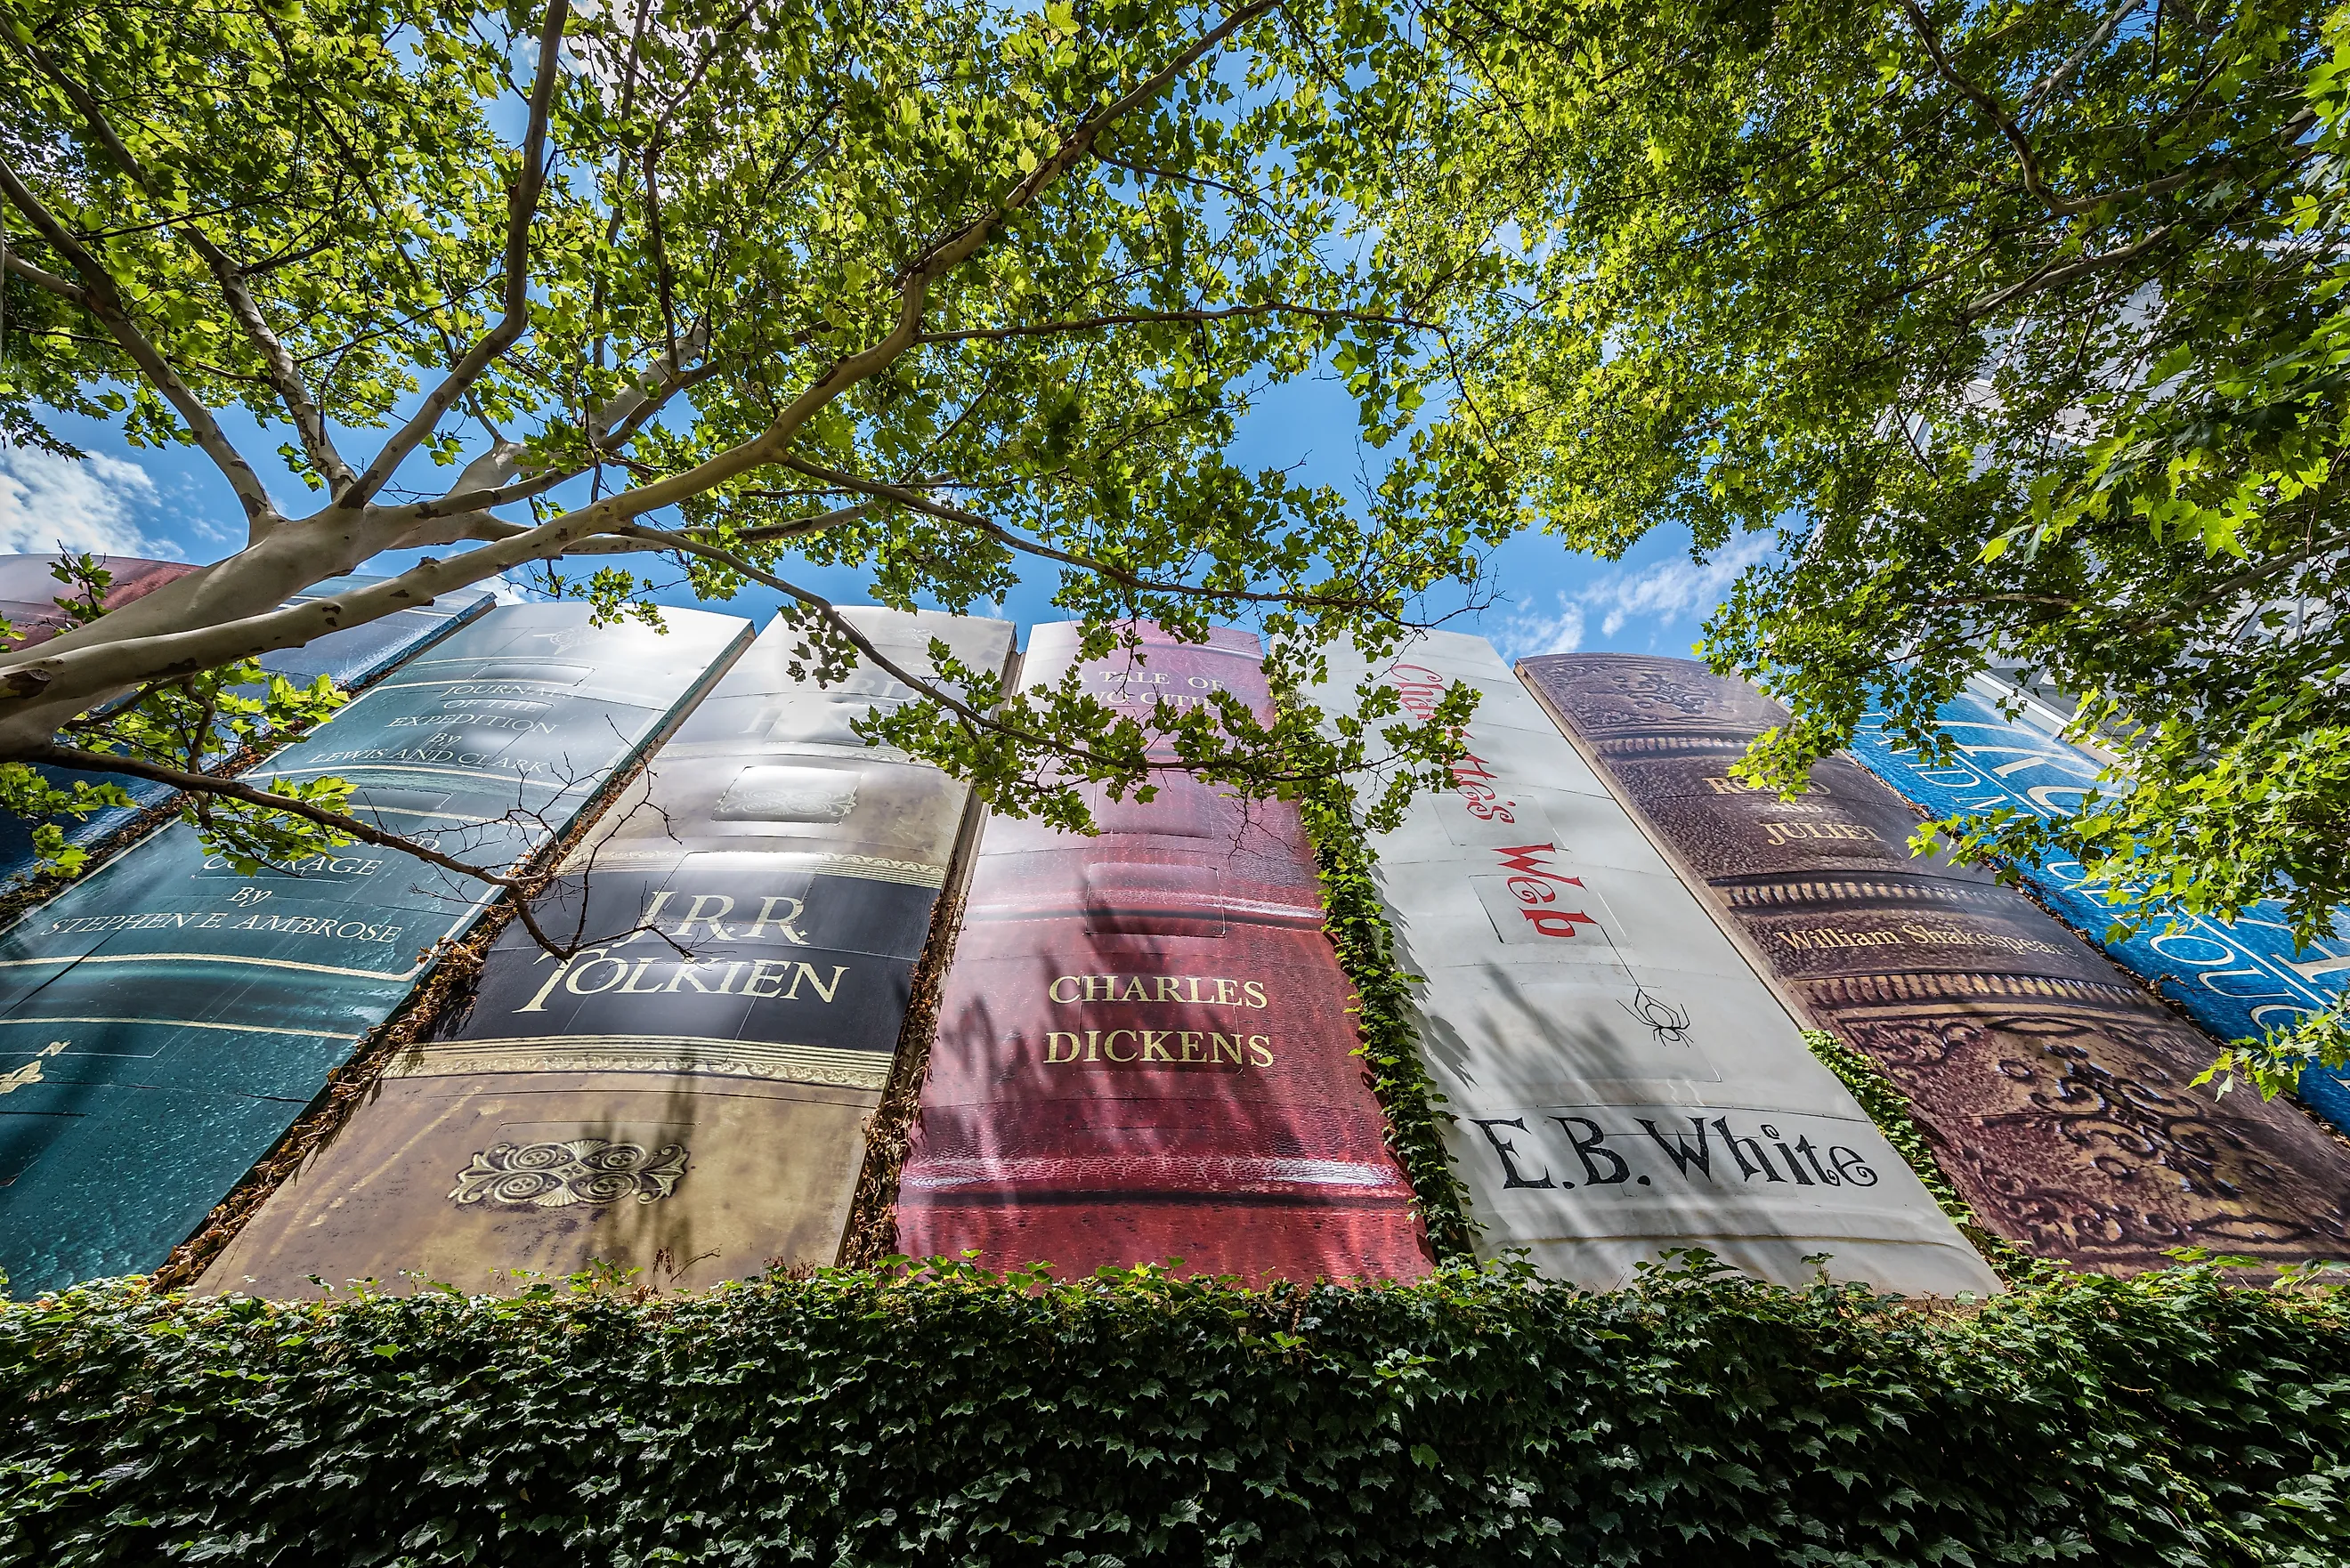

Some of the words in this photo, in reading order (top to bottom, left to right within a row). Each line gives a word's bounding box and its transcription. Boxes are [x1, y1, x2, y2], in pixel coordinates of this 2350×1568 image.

[438, 684, 578, 700] JOURNALS
[1099, 671, 1170, 684] TALE
[1188, 676, 1225, 691] OF
[443, 699, 475, 709] OF
[480, 699, 538, 713] THE
[385, 715, 559, 735] EXPEDITION
[430, 732, 463, 747] By
[308, 748, 388, 764] LEWIS
[391, 748, 454, 764] AND
[458, 752, 549, 774] CLARK
[1769, 802, 1823, 814] AND
[1760, 822, 1885, 846] JULIET
[226, 886, 274, 908] By
[1490, 842, 1600, 937] Web
[40, 913, 199, 937] STEPHEN
[202, 912, 230, 930] E.
[233, 915, 403, 944] AMBROSE
[1775, 926, 1905, 950] William
[1901, 924, 2079, 958] Shakespeare
[1049, 975, 1268, 1010] CHARLES
[1042, 1029, 1275, 1068] DICKENS
